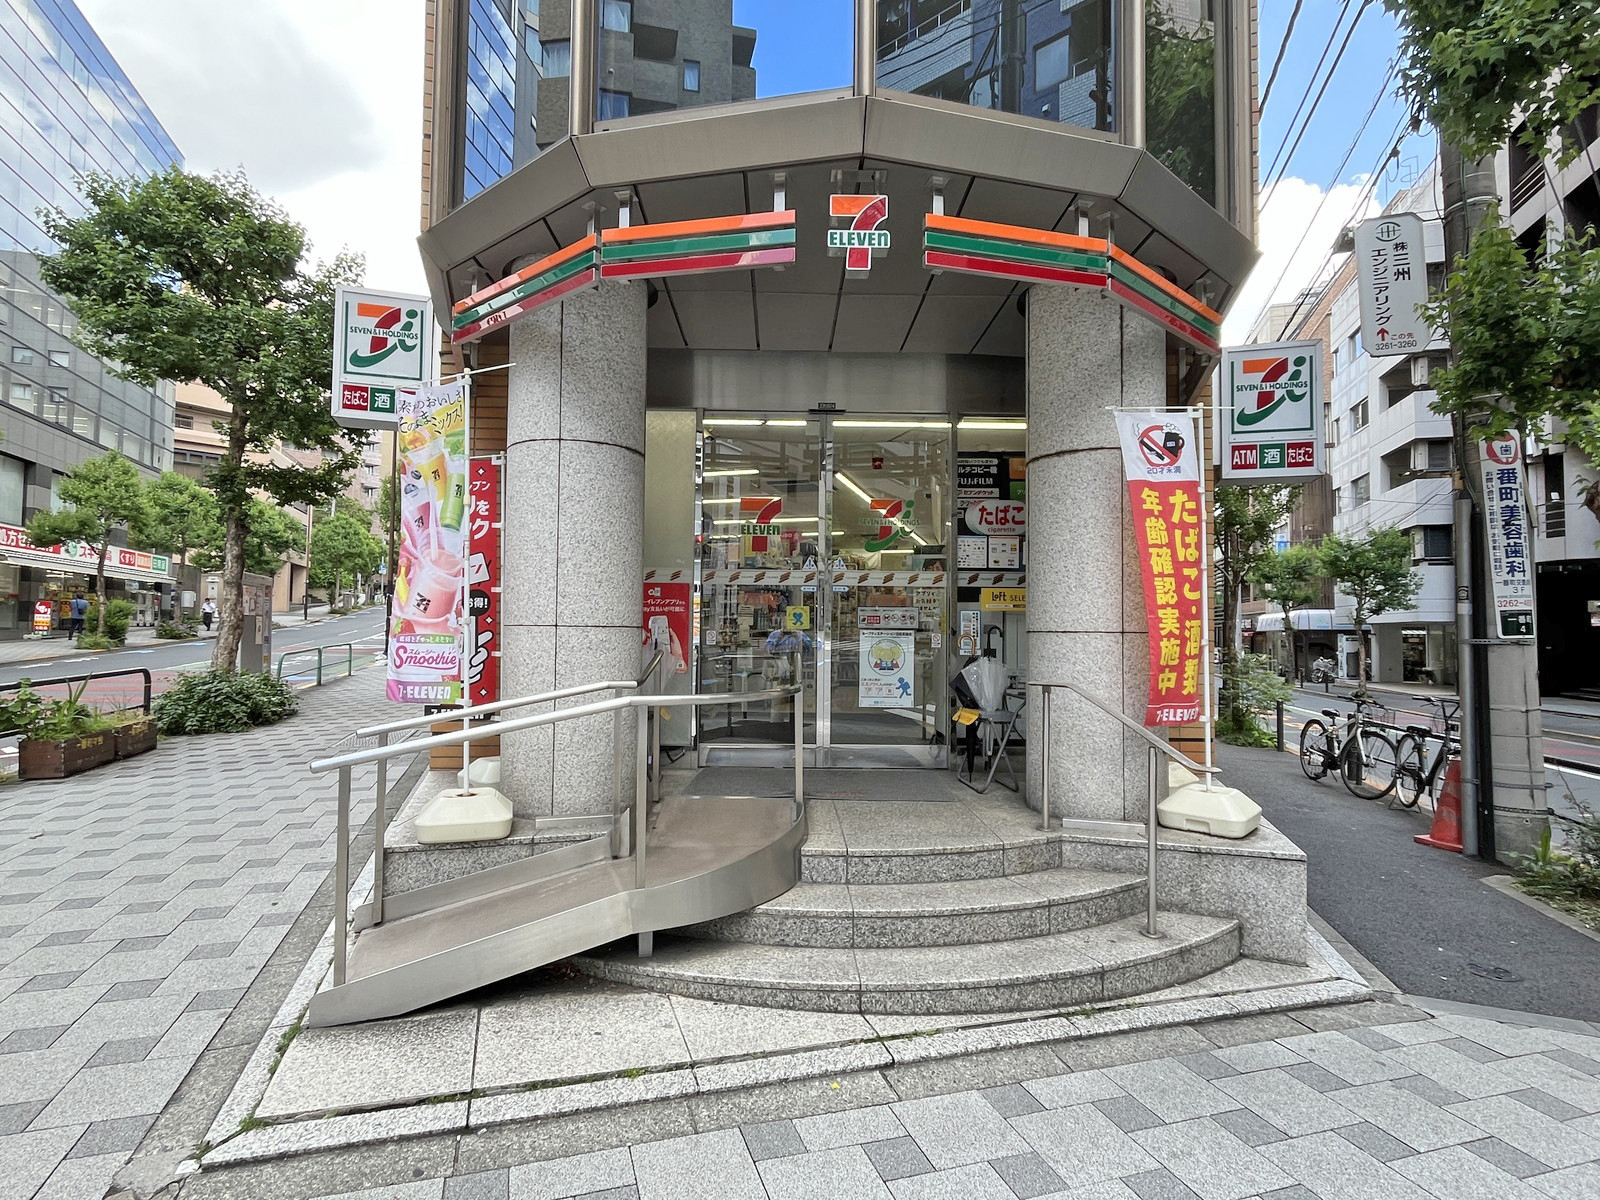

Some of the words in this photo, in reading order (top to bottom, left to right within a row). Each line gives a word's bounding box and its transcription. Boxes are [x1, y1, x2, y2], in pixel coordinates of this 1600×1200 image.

[1371, 248, 1393, 325] エンジニアリング
[382, 328, 418, 340] HOLDINGS
[1391, 332, 1414, 340] この先
[1375, 340, 1417, 351] 3261-3260
[1269, 381, 1308, 390] HOLDINGS
[343, 390, 368, 406] たばこ
[374, 393, 391, 408] 酒
[1233, 449, 1257, 465] ATM
[1264, 448, 1281, 464] 酒
[1288, 447, 1313, 462] たばこ
[1147, 466, 1182, 475] 20才未満
[979, 504, 1026, 525] たばこ
[1496, 468, 1526, 577] 番町美容歯科
[1141, 487, 1180, 695] 年齢確認実施中
[393, 645, 457, 669] Smoothie
